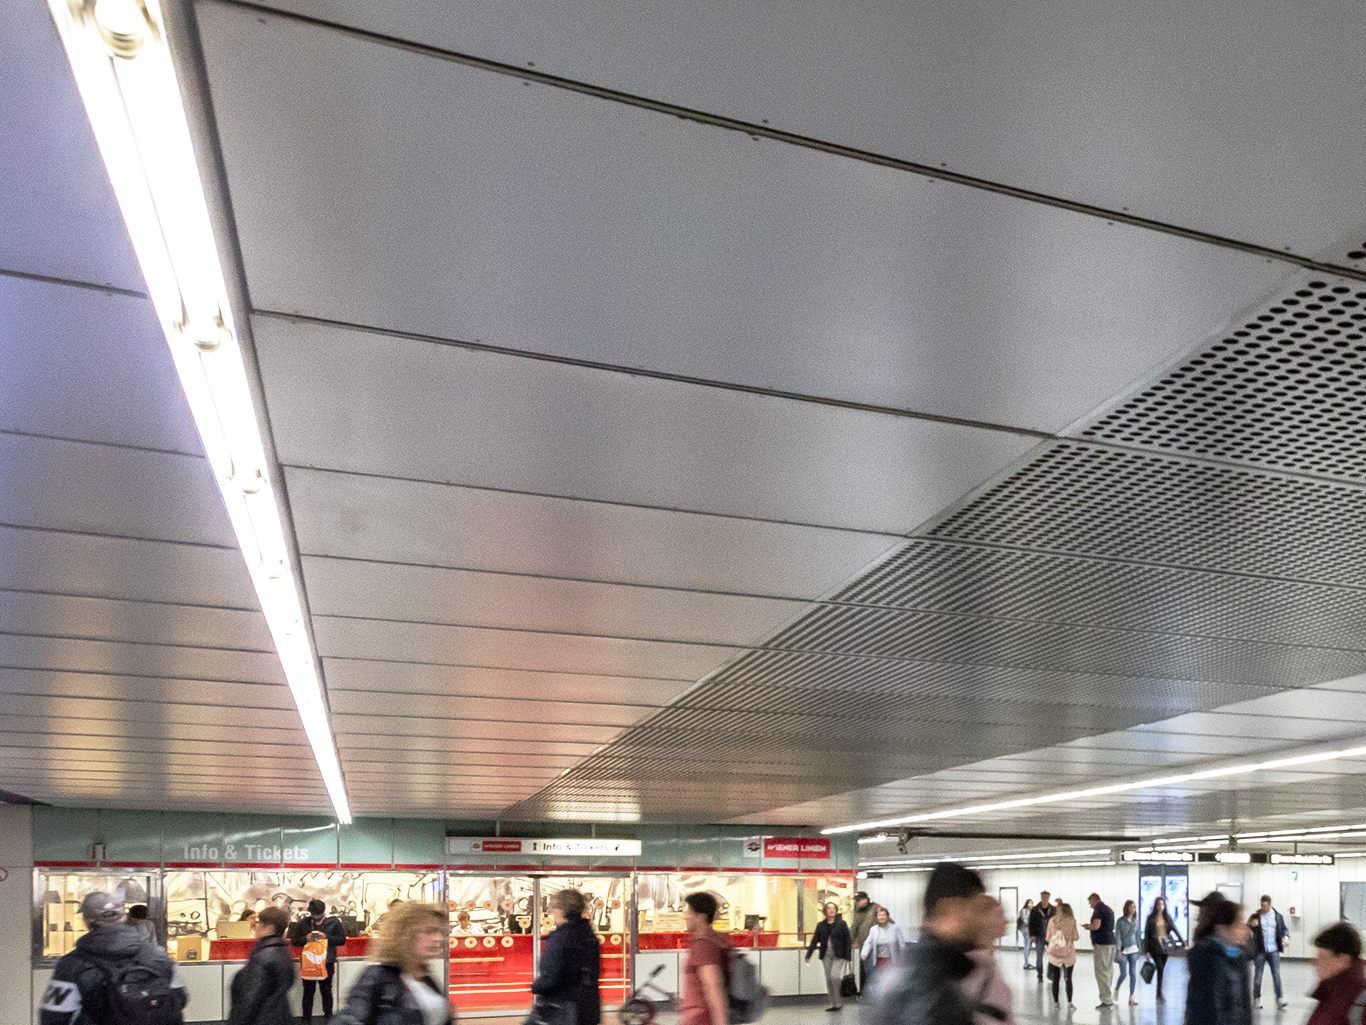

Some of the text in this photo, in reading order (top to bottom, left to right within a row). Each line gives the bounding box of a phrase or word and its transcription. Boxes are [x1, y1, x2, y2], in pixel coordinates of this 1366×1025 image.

[543, 842, 561, 850] Info
[767, 844, 799, 852] WIENER
[183, 844, 310, 860] Info & Tickets
